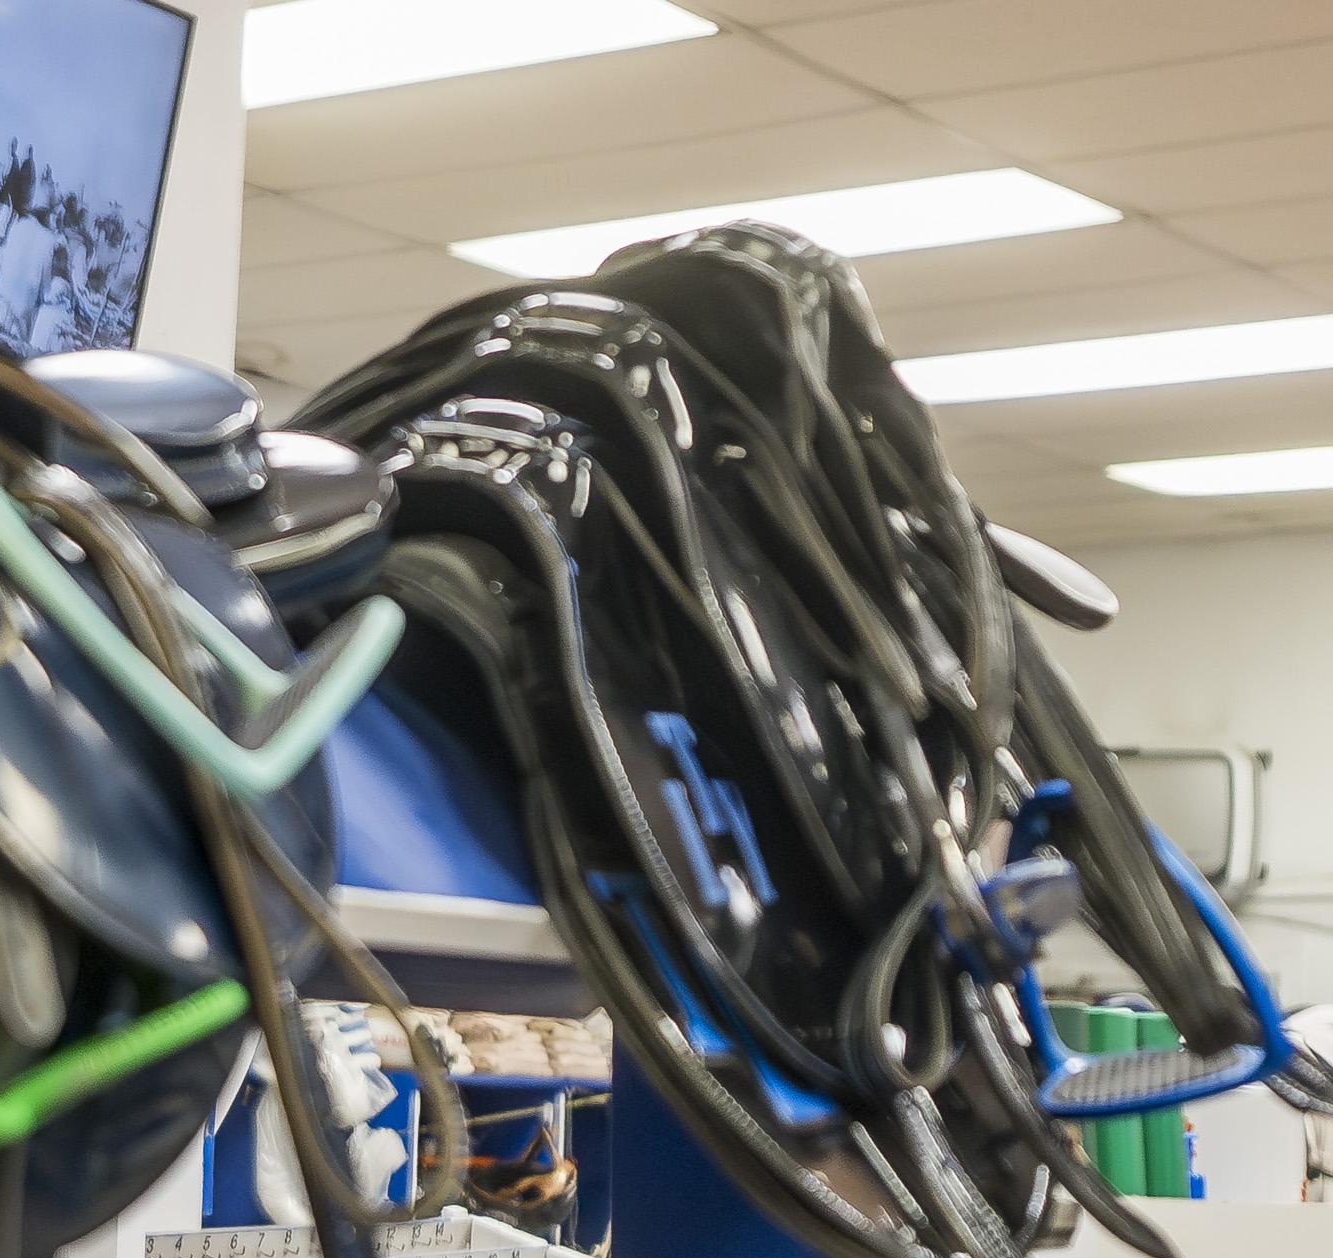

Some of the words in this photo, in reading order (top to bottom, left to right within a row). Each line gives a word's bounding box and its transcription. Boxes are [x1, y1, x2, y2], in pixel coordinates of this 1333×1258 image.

[146, 1238, 154, 1253] 3
[175, 1235, 183, 1251] 4
[203, 1235, 211, 1250] 5
[230, 1234, 238, 1249] 6
[258, 1232, 265, 1247] 7
[285, 1229, 292, 1244] 8
[412, 1224, 421, 1239] 13
[436, 1222, 444, 1237] 14
